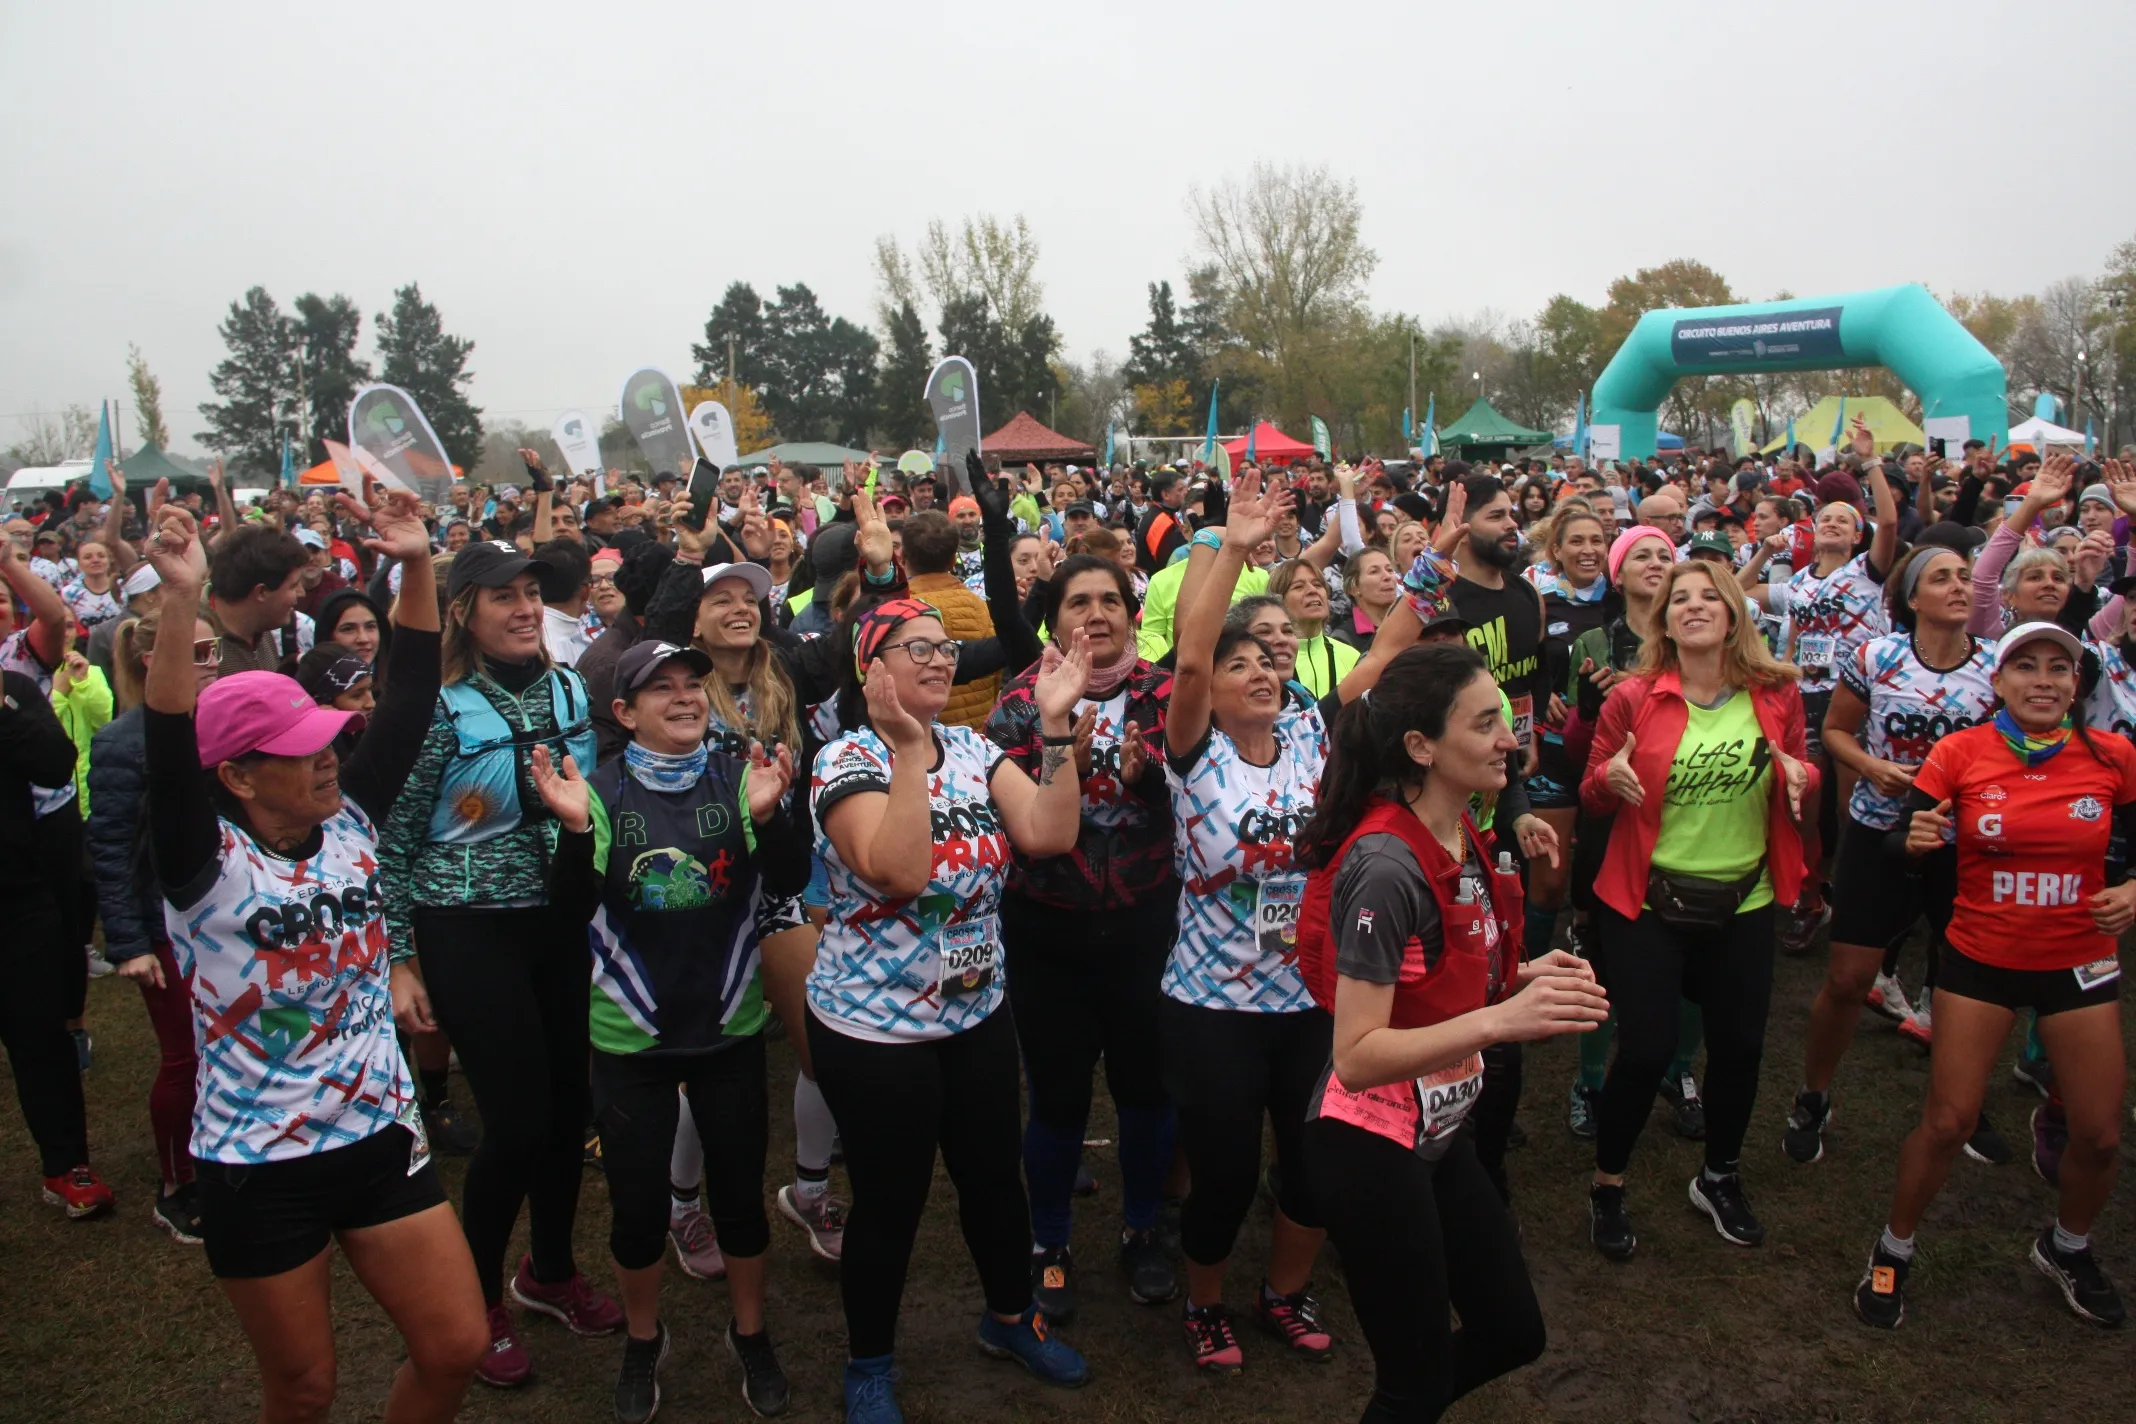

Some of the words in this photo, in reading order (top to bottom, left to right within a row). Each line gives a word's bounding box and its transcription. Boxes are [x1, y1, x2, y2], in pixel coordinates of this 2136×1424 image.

[1678, 327, 1716, 340] CIRCUITO
[1716, 325, 1752, 337] BUENOS
[1752, 322, 1778, 335] AIRES
[1779, 318, 1832, 332] AVENTURA
[1687, 739, 1744, 770] LAS
[1979, 791, 2003, 800] Claro
[616, 811, 647, 847] R
[695, 803, 730, 838] D
[1977, 813, 2002, 837] G
[1265, 884, 1299, 895] CROSS
[1993, 870, 2083, 906] PERU
[946, 926, 976, 940] CROSS
[949, 941, 993, 971] 0209
[1360, 1089, 1412, 1113] Tolerancia
[1429, 1075, 1480, 1114] 0430
